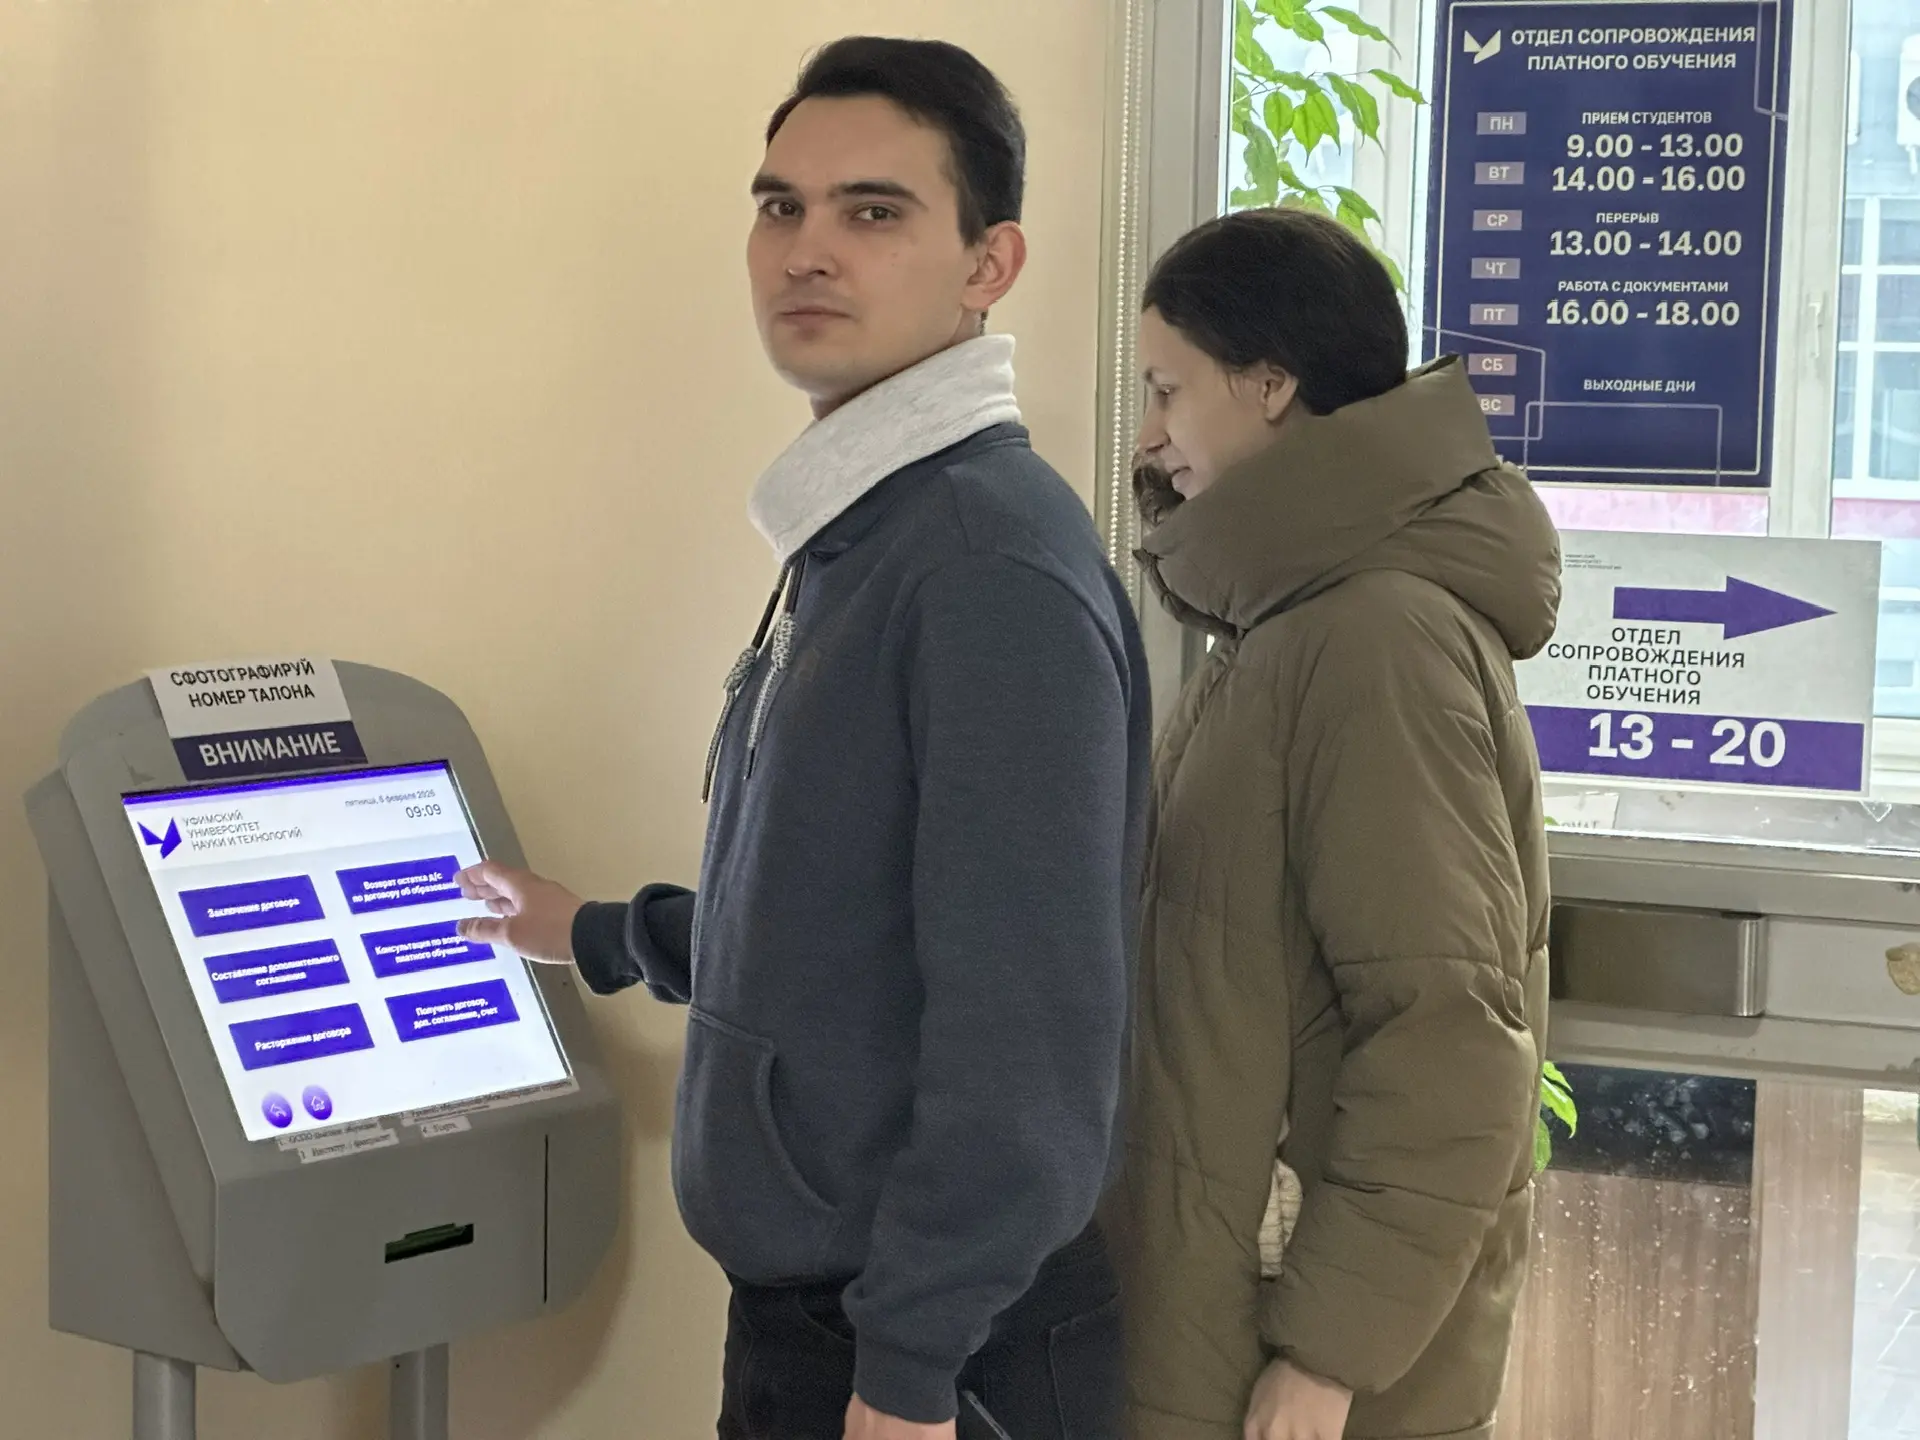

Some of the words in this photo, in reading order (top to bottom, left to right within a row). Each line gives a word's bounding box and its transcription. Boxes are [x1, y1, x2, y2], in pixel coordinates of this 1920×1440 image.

[1511, 29, 1573, 46] ОТДЕЛ
[1578, 26, 1756, 45] СОПРОВОЖДЕНИЯ
[1527, 54, 1628, 71] ПЛАТНОГО
[1632, 53, 1737, 70] ОБУЧЕНИЯ
[1489, 117, 1514, 131] ПН
[1582, 112, 1629, 124] ПРИЕМ
[1632, 111, 1713, 125] СТУДЕНТОВ
[1566, 133, 1634, 158] 9.00
[1659, 133, 1744, 158] 13.00
[1488, 166, 1510, 180] ВТ
[1552, 166, 1635, 191] 14.00
[1661, 165, 1746, 191] 16.00
[1486, 214, 1509, 228] СР
[1596, 212, 1660, 224] ПЕРЕРЫВ
[1550, 231, 1632, 256] 13.00
[1658, 231, 1742, 256] 14.00
[1485, 261, 1507, 276] ЧТ
[1558, 281, 1609, 292] РАБОТА
[1612, 281, 1621, 292] С
[1623, 281, 1729, 293] ДОКУМЕНТАМИ
[1483, 307, 1506, 322] ПТ
[1546, 301, 1629, 325] 16.00
[1655, 301, 1740, 325] 18.00
[1481, 357, 1503, 372] СБ
[1583, 379, 1662, 392] ВЫХОДНЫЕ
[1665, 380, 1696, 393] ДНИ
[1612, 627, 1681, 645] ОТДЕЛ
[1548, 643, 1745, 669] СОПРОВОЖДЕНИЯ
[170, 658, 316, 686] СФОТОГРАФИРУЙ
[1588, 664, 1701, 685] ПЛАТНОГО
[188, 689, 246, 708] НОМЕР
[248, 683, 316, 703] ТАЛОНА
[1587, 684, 1701, 705] ОБУЧЕНИЯ
[199, 731, 341, 767] ВНИМАНИЕ
[1589, 712, 1654, 760] 13
[1671, 738, 1694, 750] -
[1709, 718, 1786, 768] 20
[182, 809, 244, 827] УФИМСКИЙ
[405, 803, 442, 819] 09:09
[186, 821, 260, 839] УНИВЕРСИТЕТ
[191, 838, 227, 852] НАУКИ
[229, 836, 236, 846] И
[237, 826, 303, 845] ТЕХНОЛОГИЙ
